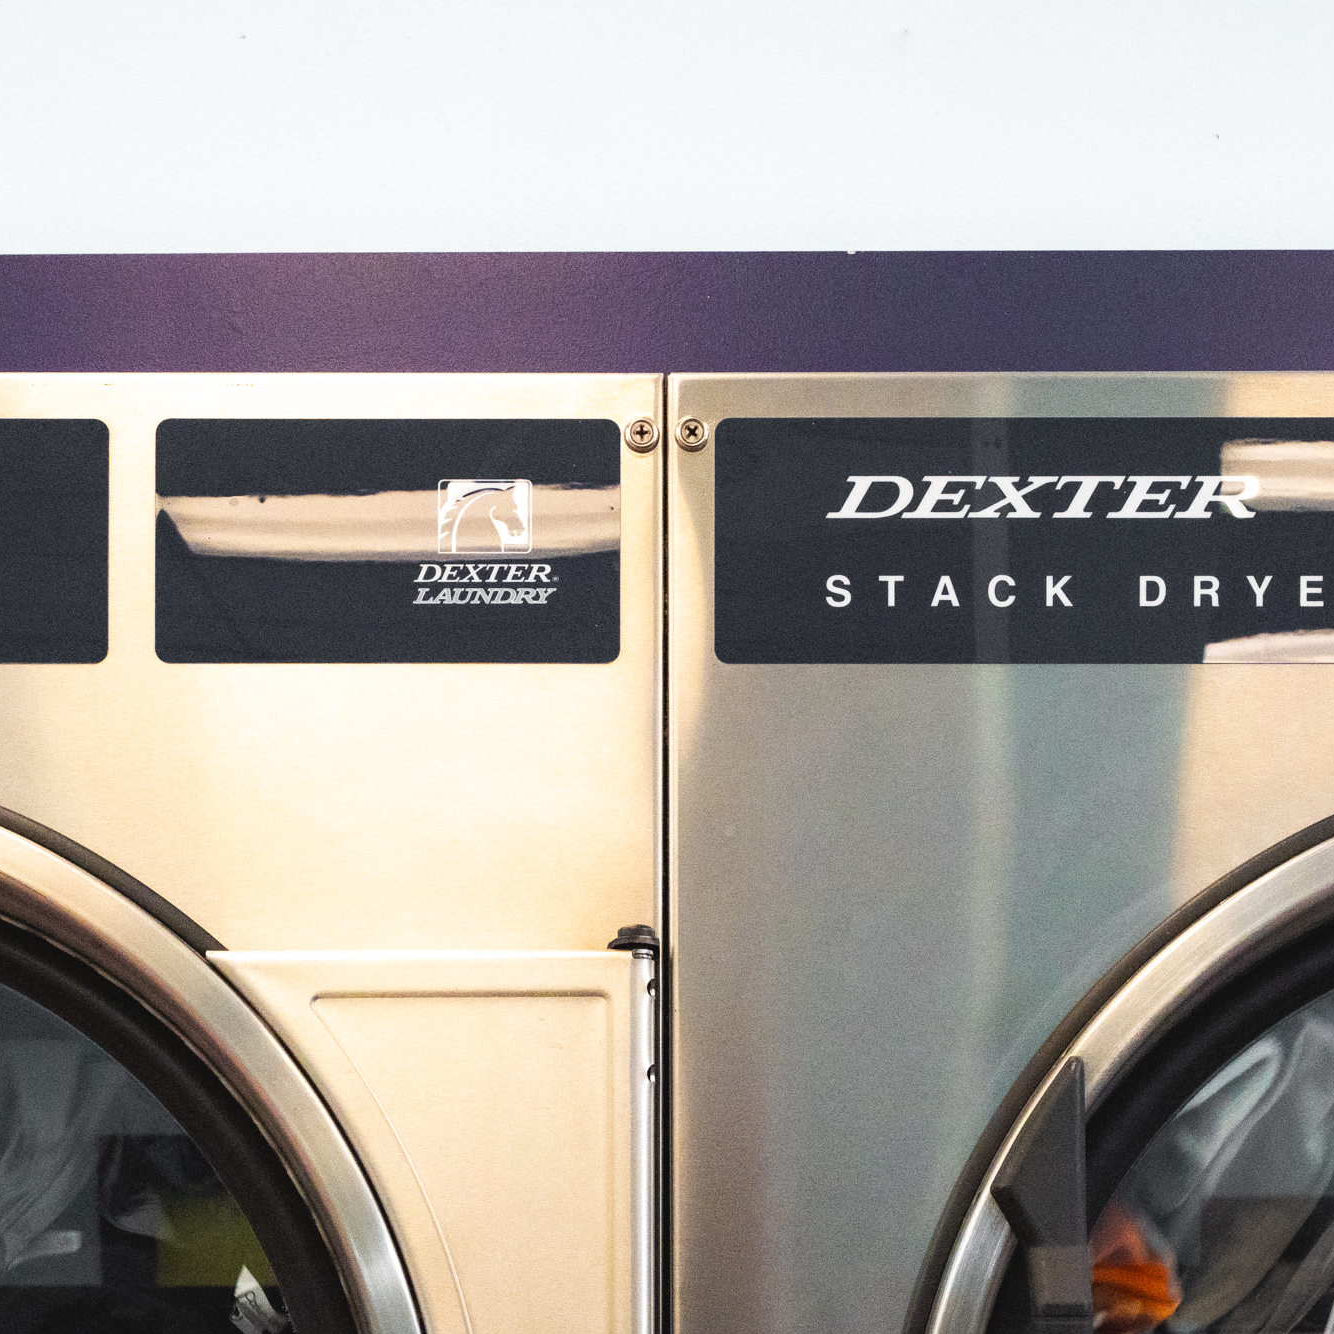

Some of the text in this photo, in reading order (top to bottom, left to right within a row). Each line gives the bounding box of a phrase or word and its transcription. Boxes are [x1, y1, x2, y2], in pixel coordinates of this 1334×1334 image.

[825, 475, 1260, 519] DEXTER
[413, 588, 557, 605] LAUNDRY
[825, 575, 1074, 607] STACK
